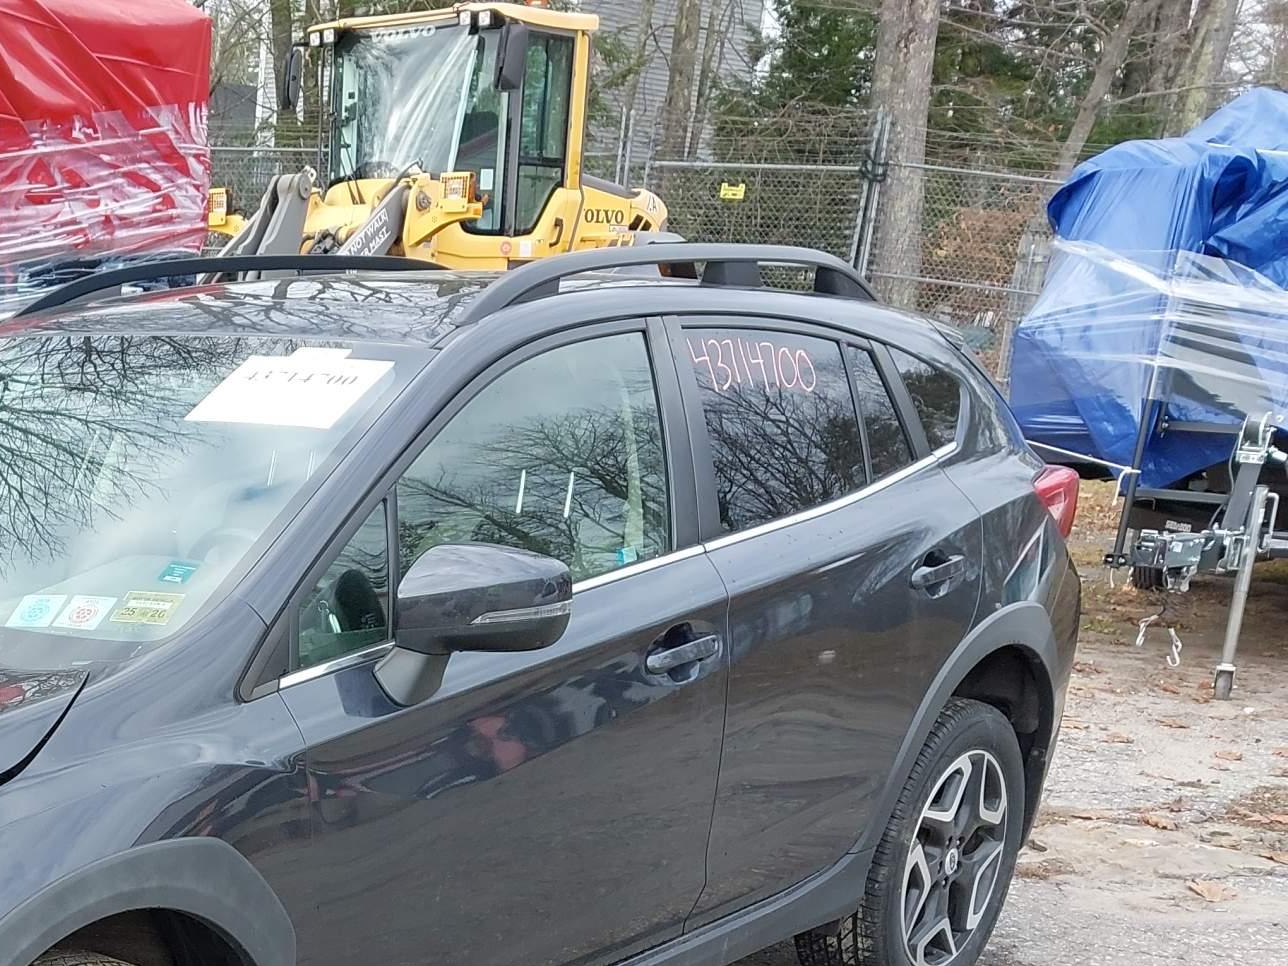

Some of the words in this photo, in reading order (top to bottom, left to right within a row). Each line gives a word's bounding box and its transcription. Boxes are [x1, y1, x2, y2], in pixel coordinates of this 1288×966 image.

[369, 25, 436, 42] VOLVO
[584, 208, 624, 224] OLVO
[686, 337, 817, 393] 43714700
